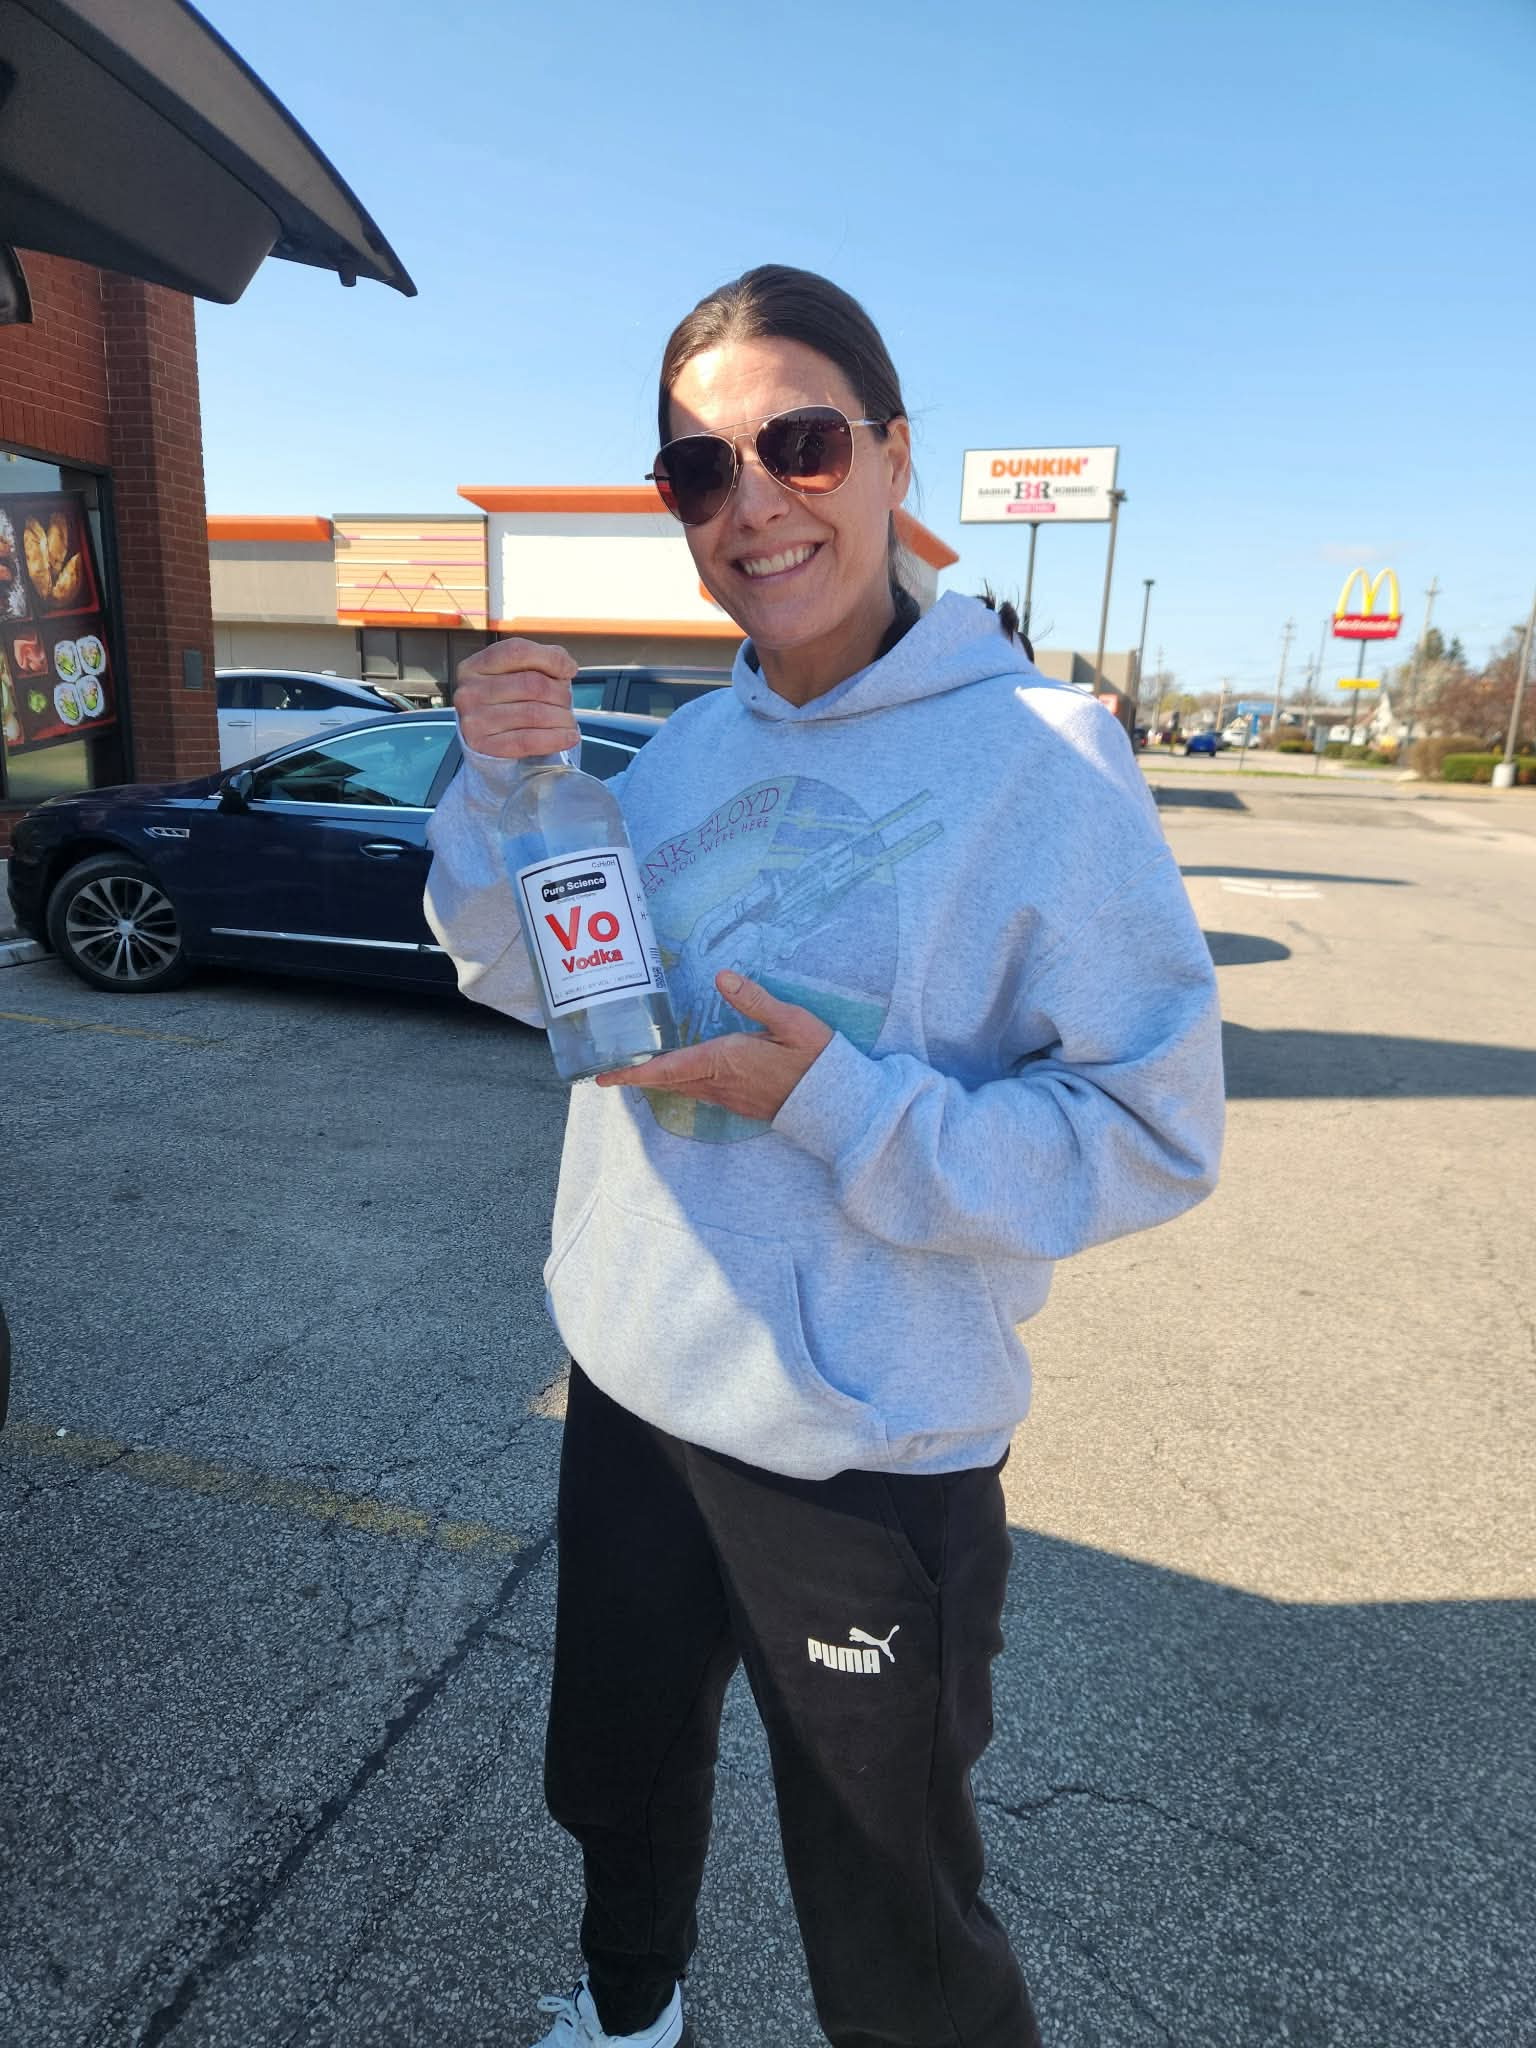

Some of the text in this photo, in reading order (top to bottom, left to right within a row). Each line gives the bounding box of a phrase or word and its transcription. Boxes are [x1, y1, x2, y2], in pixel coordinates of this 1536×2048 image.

[990, 457, 1089, 478] DUNKIN'
[640, 787, 780, 890] INK FLOYD
[703, 832, 735, 853] WERE
[741, 816, 769, 833] HERE
[543, 877, 605, 898] Pure Science
[544, 905, 620, 952] Vo
[561, 949, 624, 973] Vodka
[808, 1638, 880, 1674] PUMA
